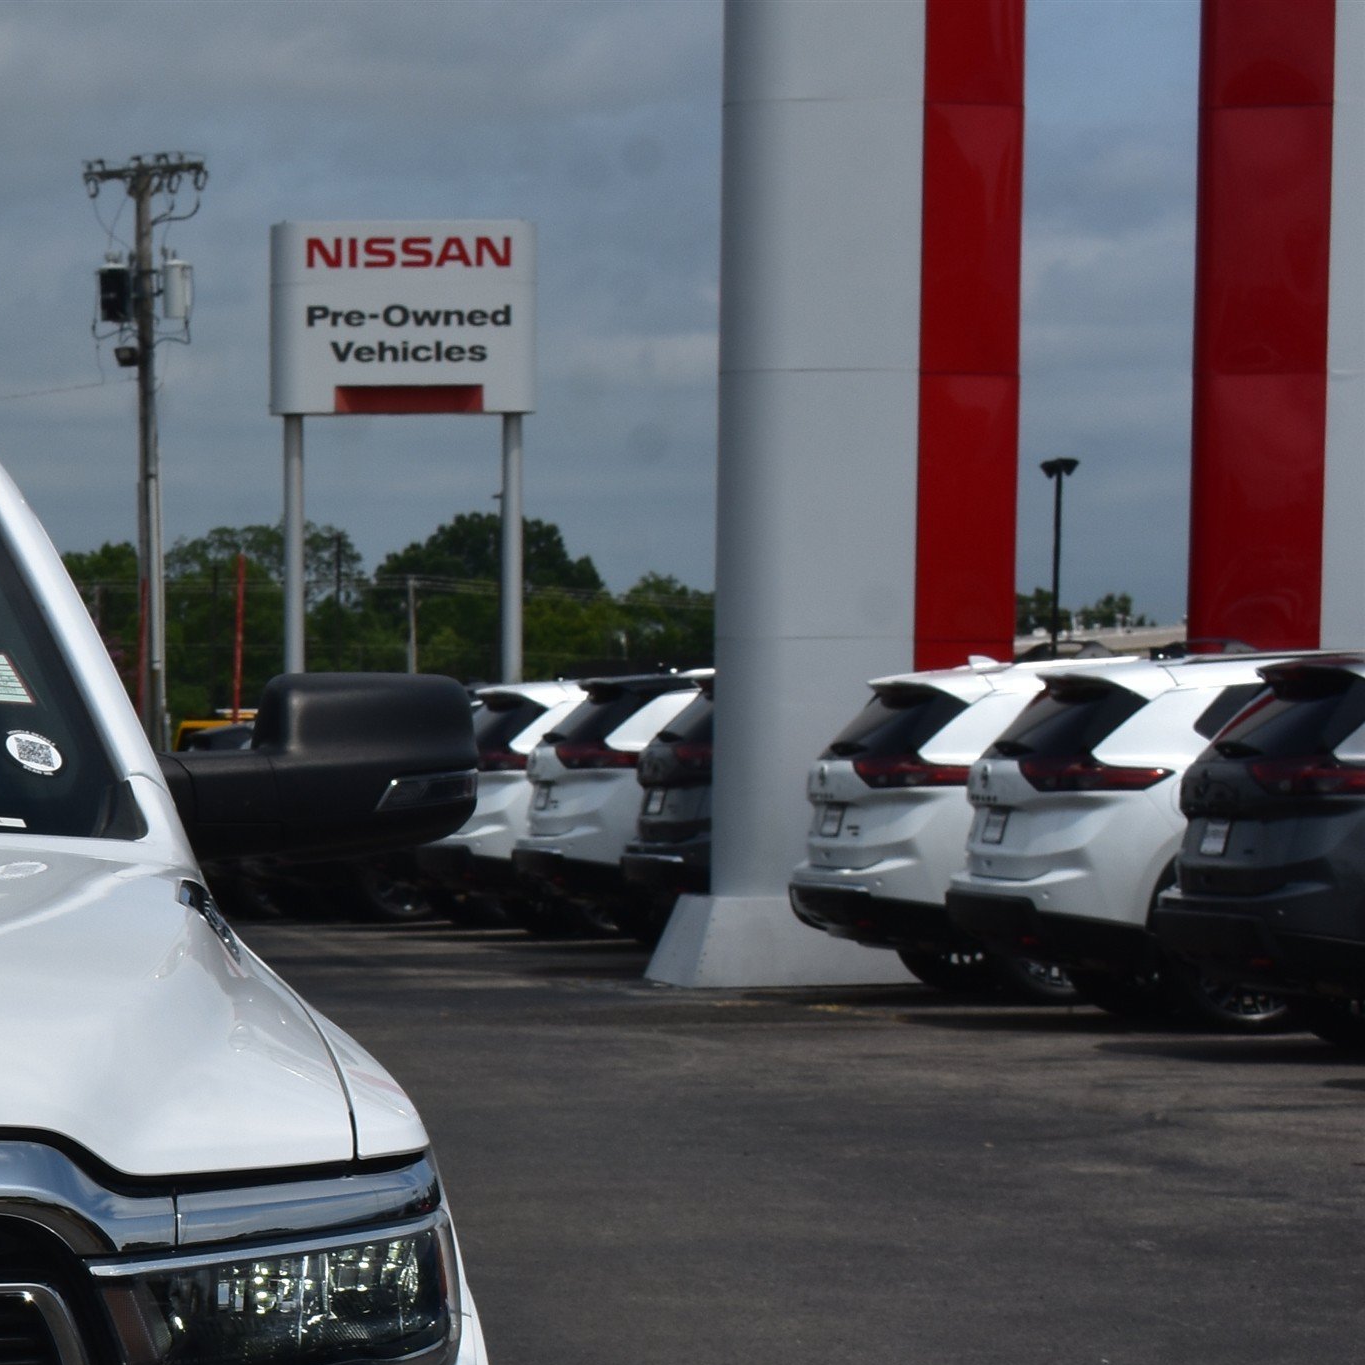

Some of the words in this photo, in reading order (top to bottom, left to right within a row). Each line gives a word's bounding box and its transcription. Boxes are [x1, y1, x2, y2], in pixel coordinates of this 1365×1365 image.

[305, 236, 512, 269] NISSAN
[305, 304, 512, 327] Pre-Owned
[330, 340, 488, 363] Vehicles
